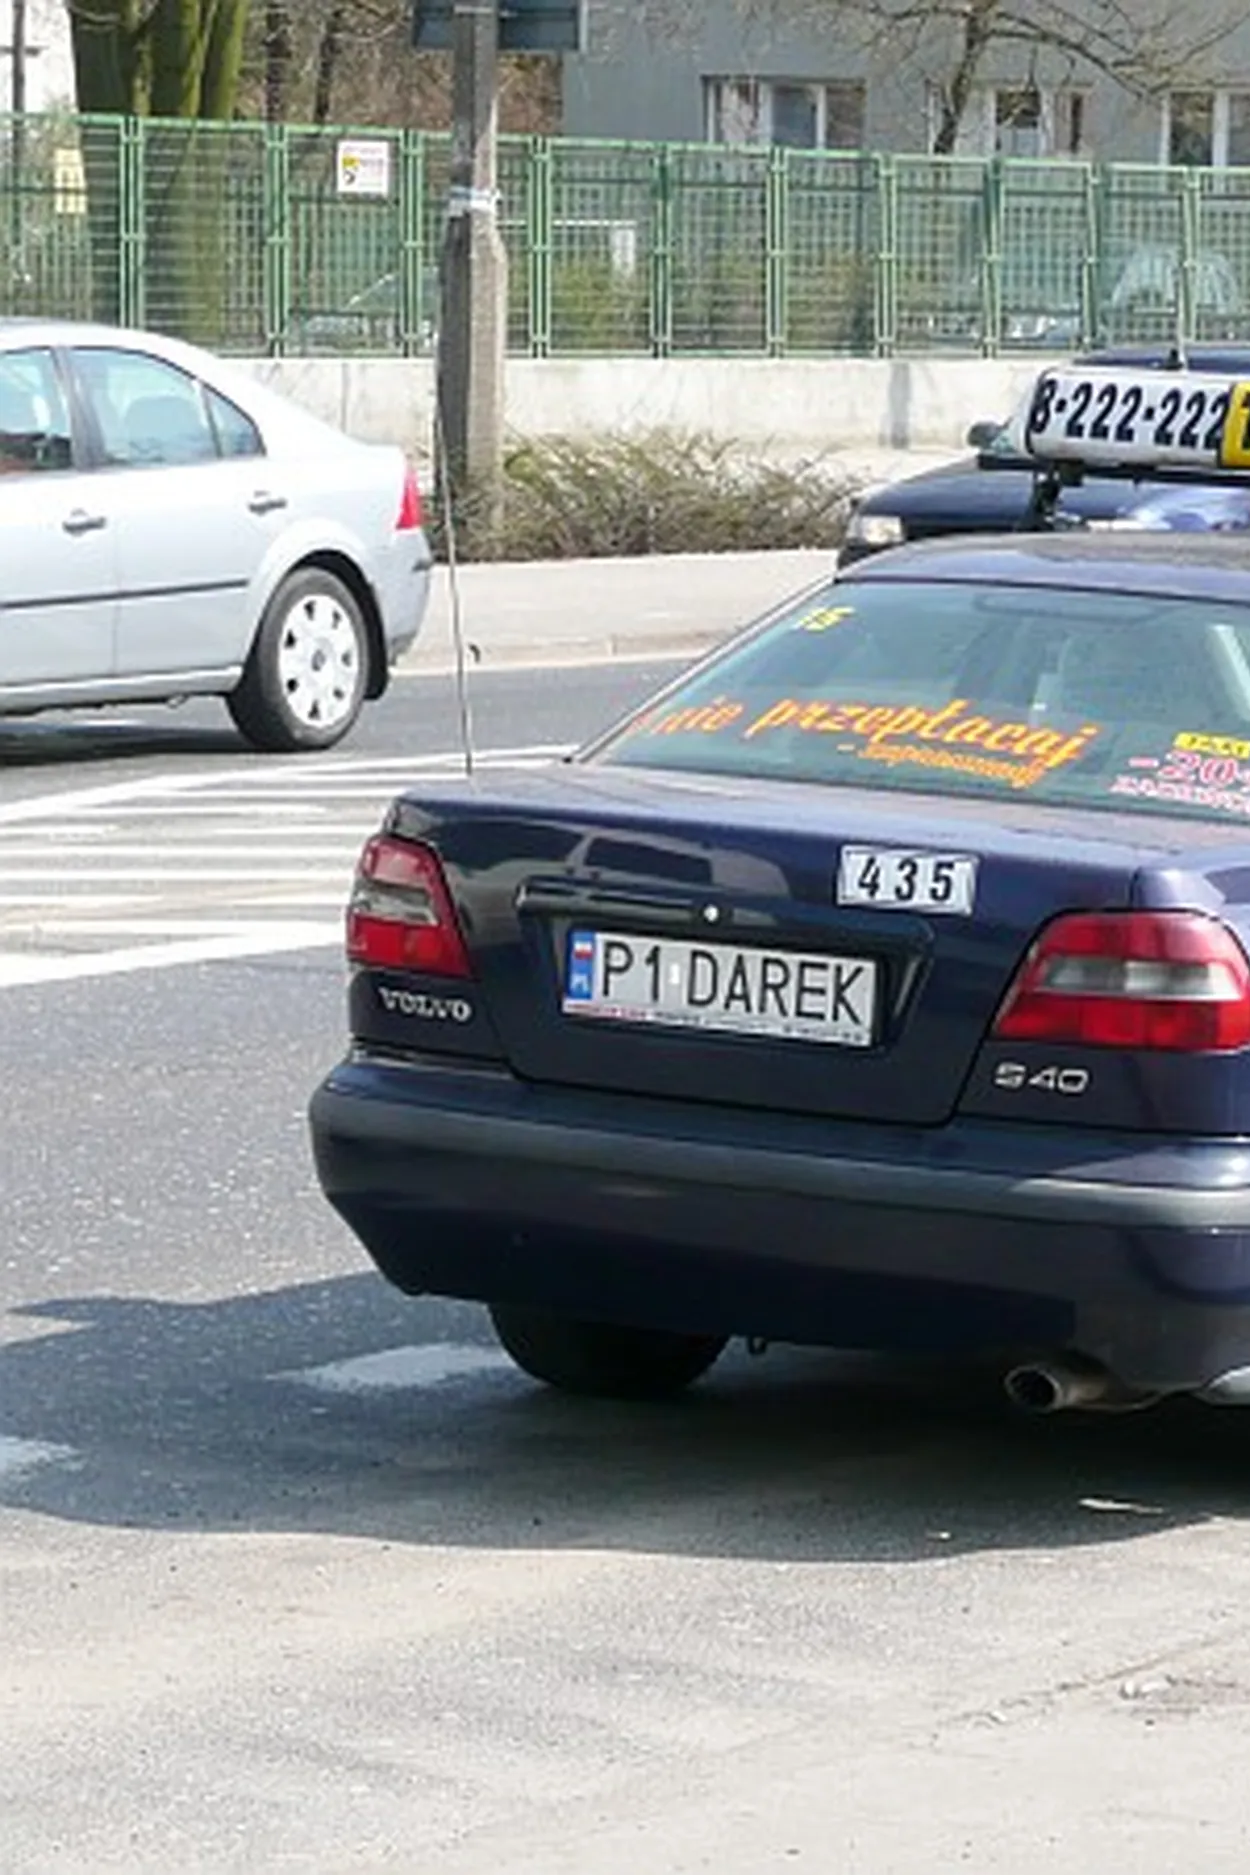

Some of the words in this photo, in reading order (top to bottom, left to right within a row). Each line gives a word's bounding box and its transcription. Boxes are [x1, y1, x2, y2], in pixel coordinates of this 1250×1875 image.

[858, 858, 955, 903] 435
[602, 940, 662, 1001] P1
[687, 950, 865, 1026] DAREK
[378, 986, 472, 1022] VOLVO
[994, 1062, 1090, 1093] S40
